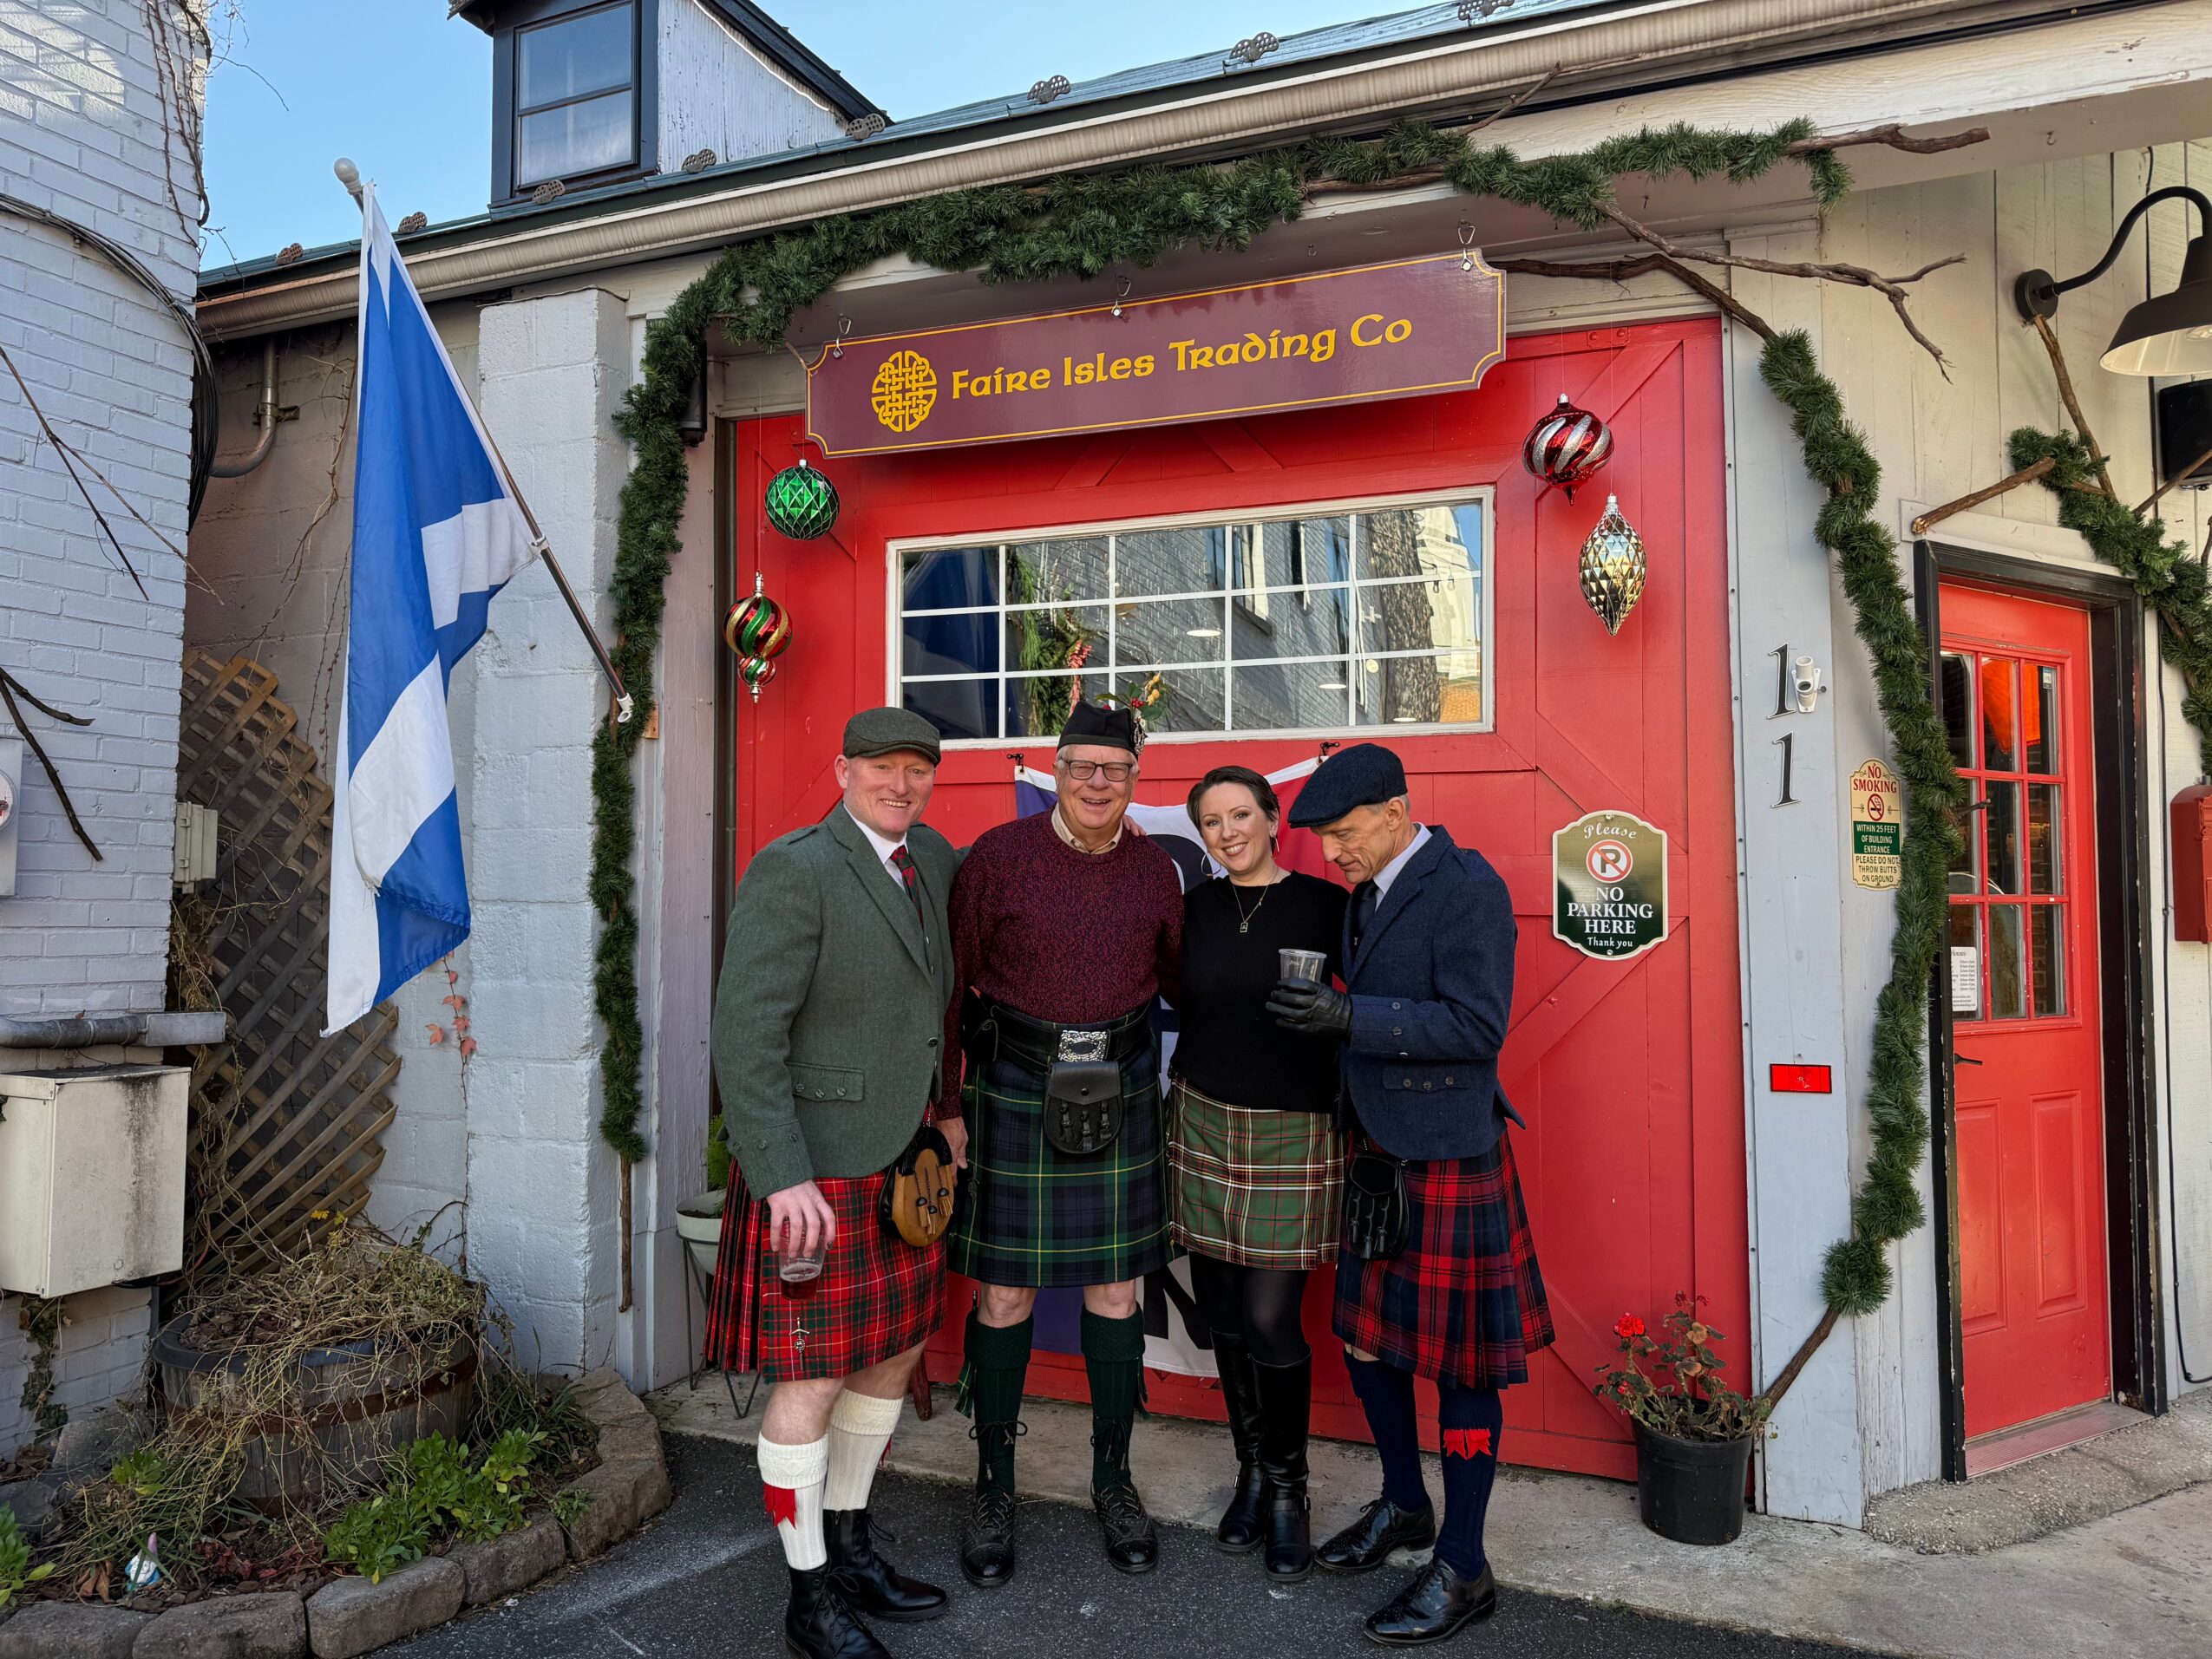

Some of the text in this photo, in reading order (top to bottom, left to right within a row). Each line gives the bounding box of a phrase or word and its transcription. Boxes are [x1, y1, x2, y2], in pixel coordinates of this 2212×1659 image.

[952, 313, 1413, 400] Faire Isles Trading Co
[1868, 765, 1882, 779] NO
[1853, 778, 1897, 794] SMOKING
[1583, 822, 1637, 839] Please
[1856, 823, 1897, 833] WITHIN 25 FEET
[1861, 834, 1893, 844] OF BUILDING
[1863, 845, 1890, 854] ENTRANCE
[1855, 855, 1900, 865] PLEASE DO NOT
[1858, 865, 1897, 874] THROW BUTTS
[1862, 874, 1870, 883] ON
[1595, 886, 1625, 902] NO
[1567, 902, 1653, 919] PARKING
[1584, 918, 1637, 935] HERE
[1587, 937, 1633, 950] Thank you
